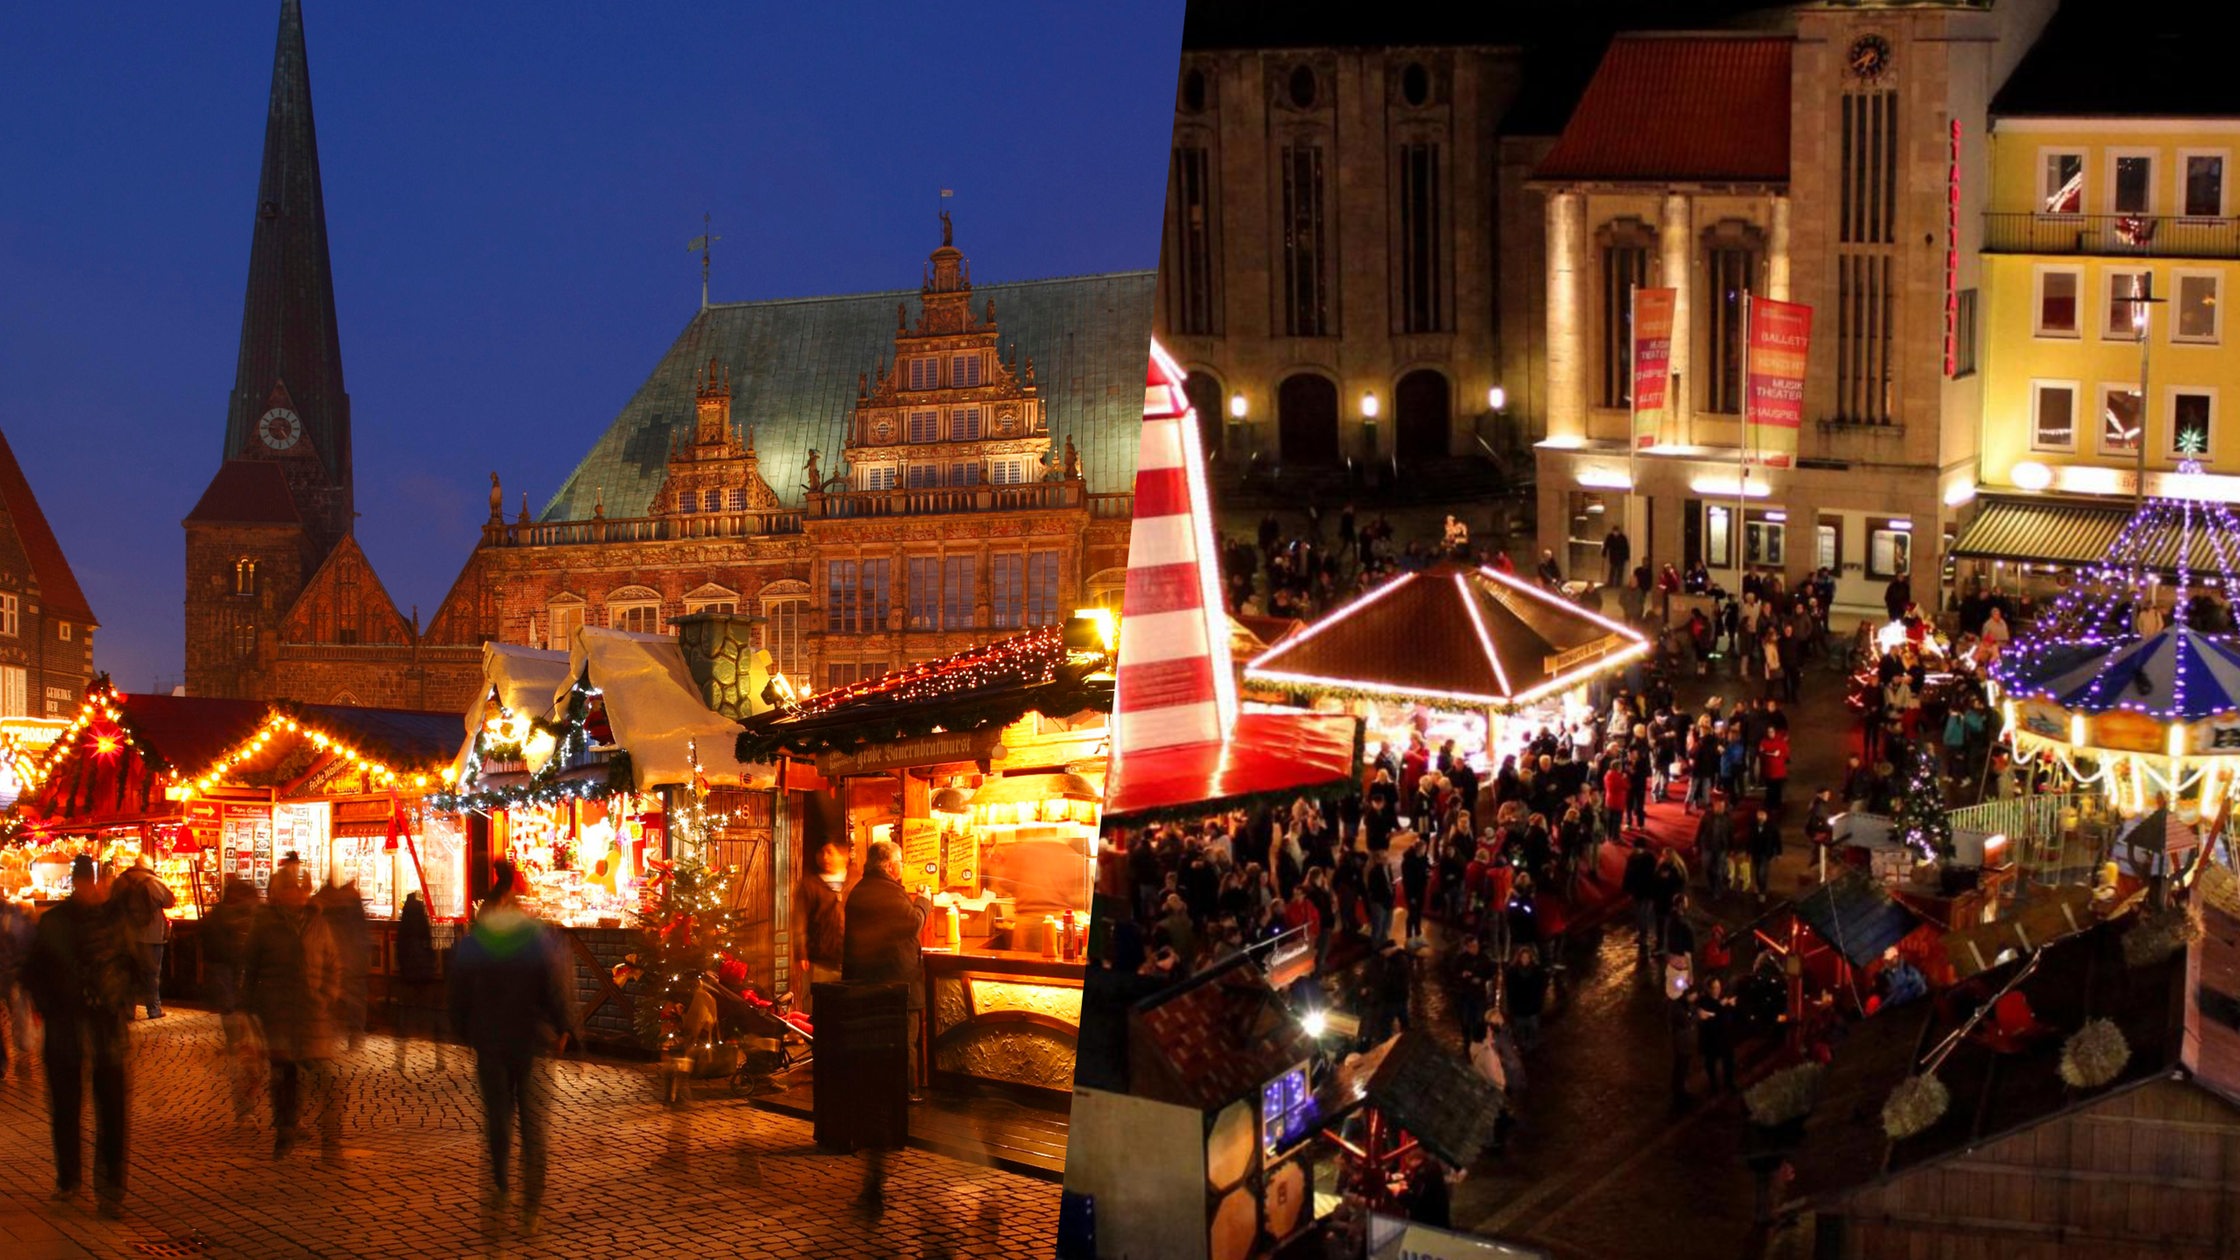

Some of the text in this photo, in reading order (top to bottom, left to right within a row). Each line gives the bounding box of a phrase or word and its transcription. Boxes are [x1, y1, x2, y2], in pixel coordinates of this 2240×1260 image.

[1772, 378, 1804, 390] MUSIK
[1756, 385, 1803, 401] THEATER
[884, 736, 972, 762] Bauernbratwurst
